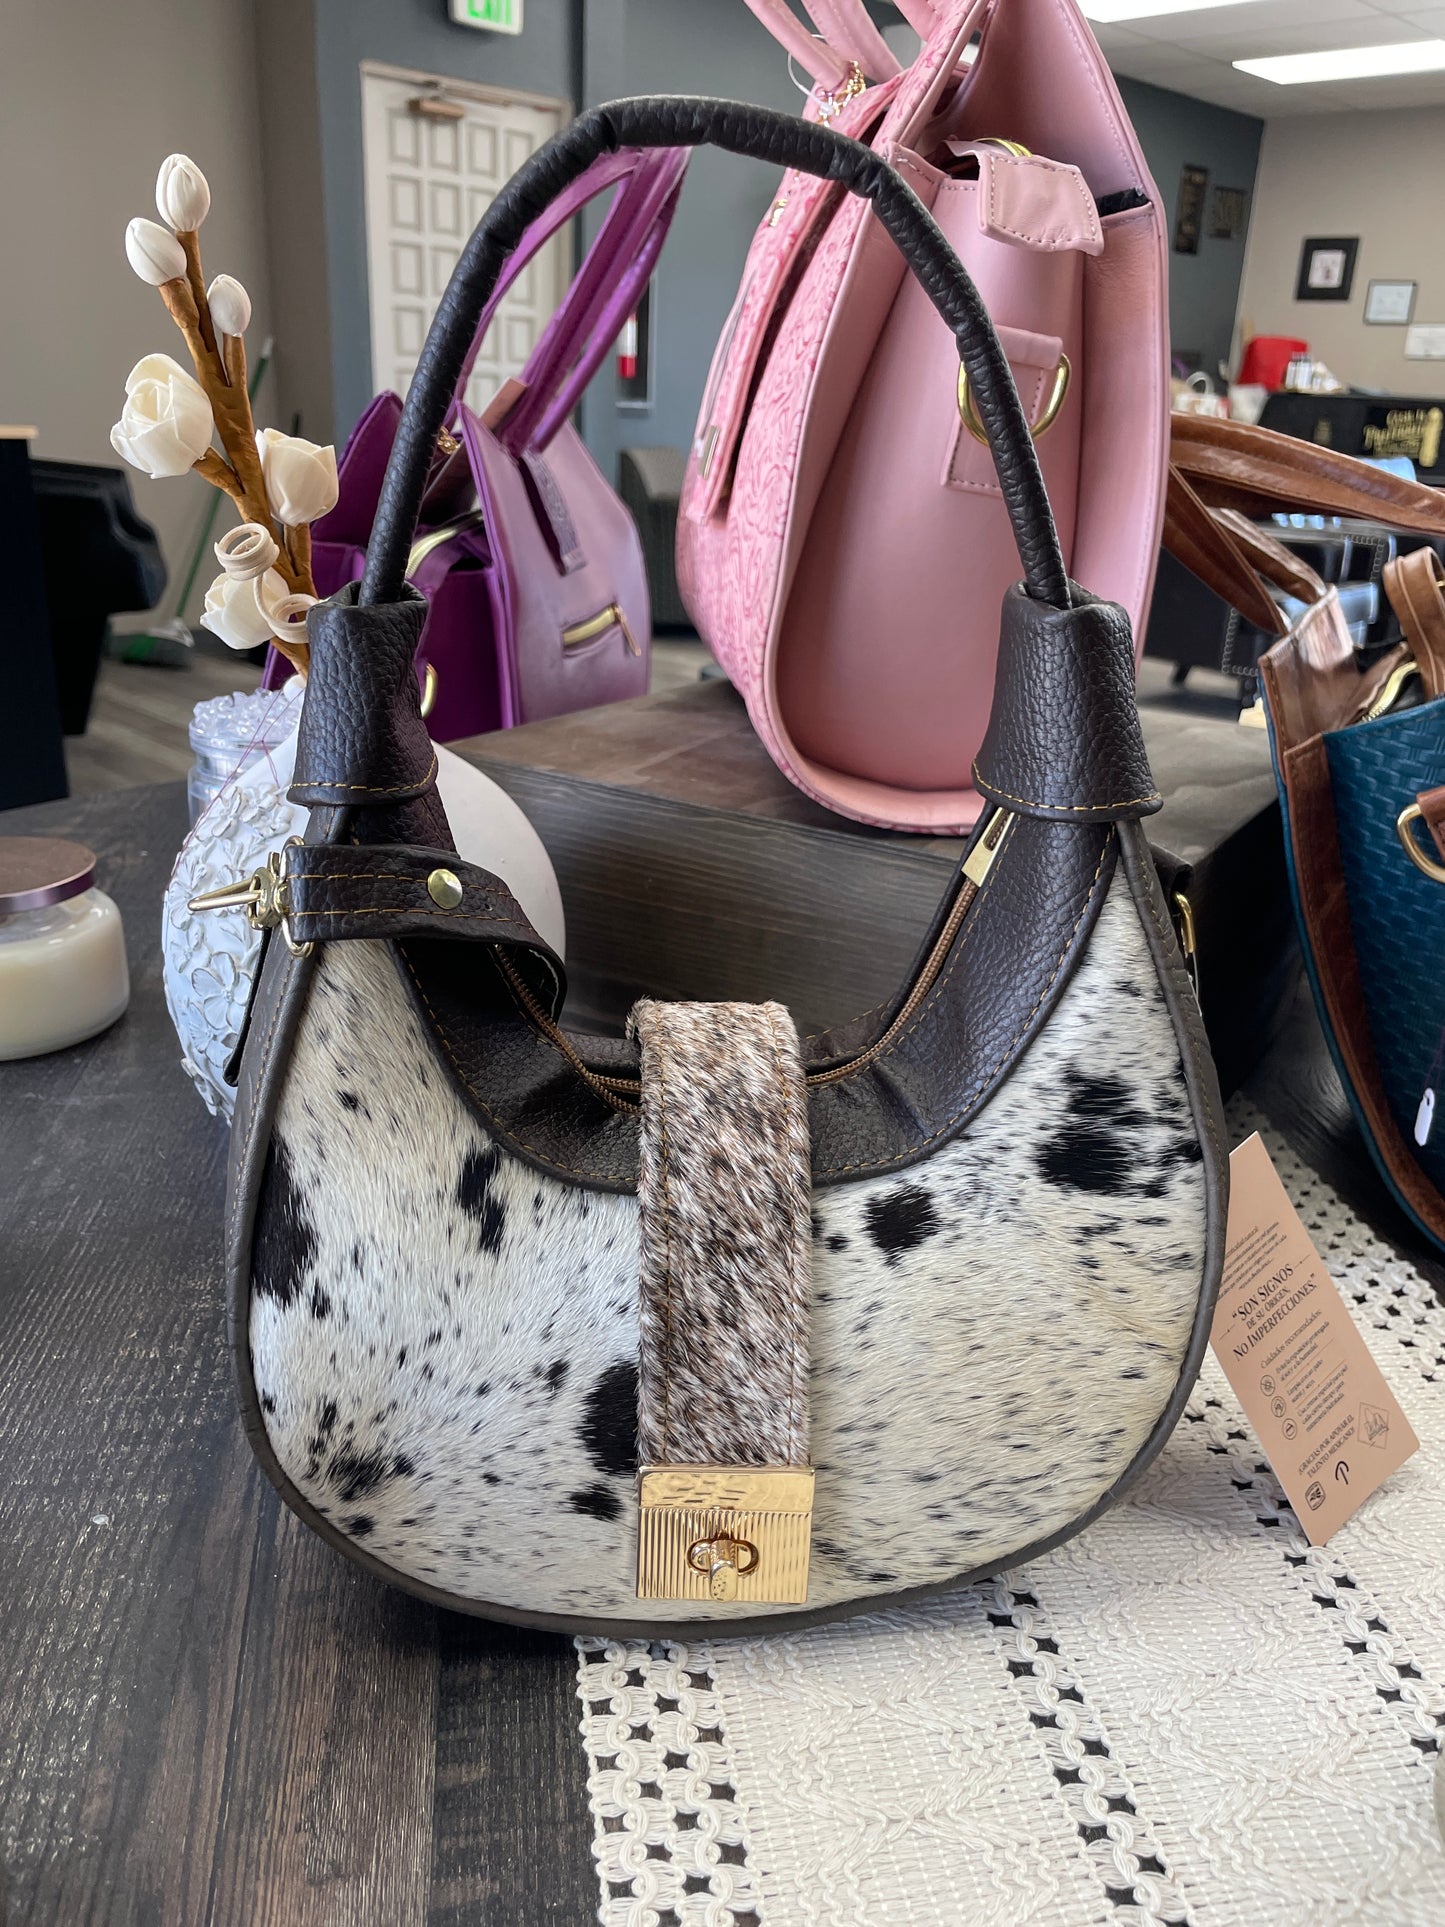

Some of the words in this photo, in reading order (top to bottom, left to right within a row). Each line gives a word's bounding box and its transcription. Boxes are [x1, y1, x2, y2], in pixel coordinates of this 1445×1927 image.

[1257, 1263, 1293, 1301] SIGNOS
[1245, 1316, 1256, 1329] DE
[1255, 1310, 1264, 1320] SU
